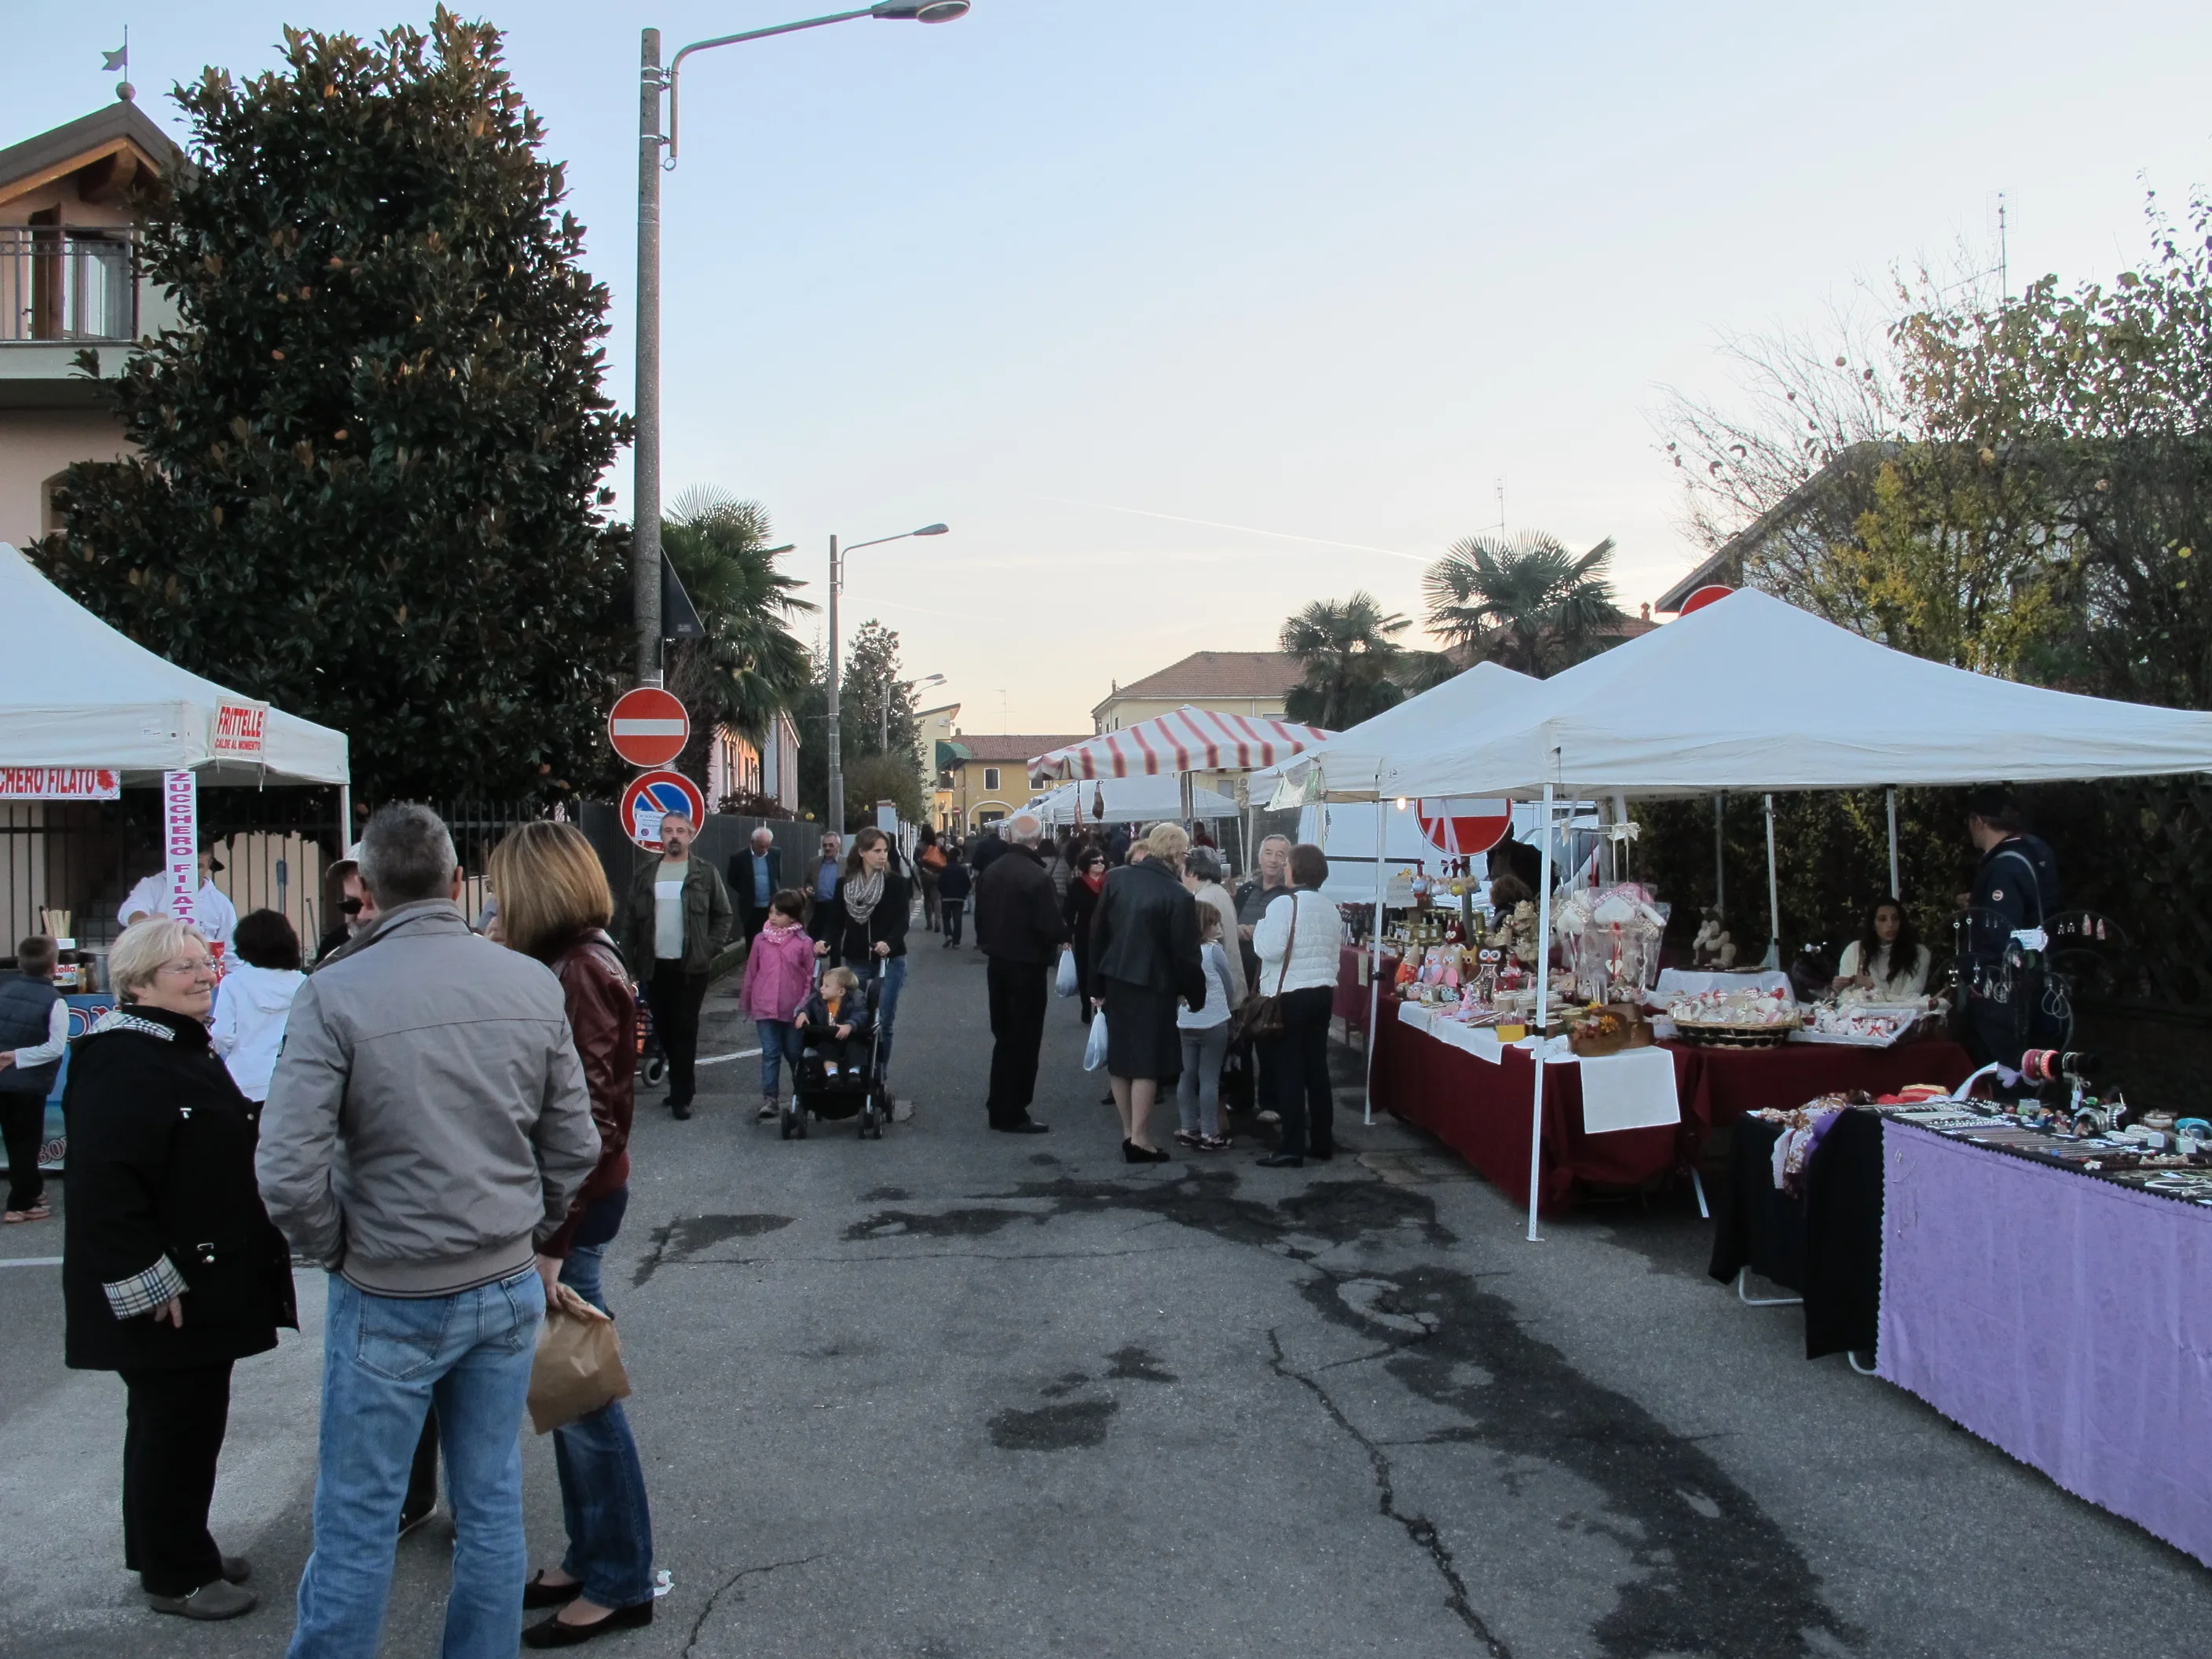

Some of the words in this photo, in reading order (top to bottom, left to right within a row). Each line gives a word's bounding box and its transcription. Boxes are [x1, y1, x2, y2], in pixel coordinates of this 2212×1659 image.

[217, 705, 264, 738] FRITTELLE
[215, 738, 232, 749] CALDE
[238, 740, 261, 752] MOMENTO
[47, 768, 95, 794] FILATO
[169, 773, 193, 856] ZUCCHERO
